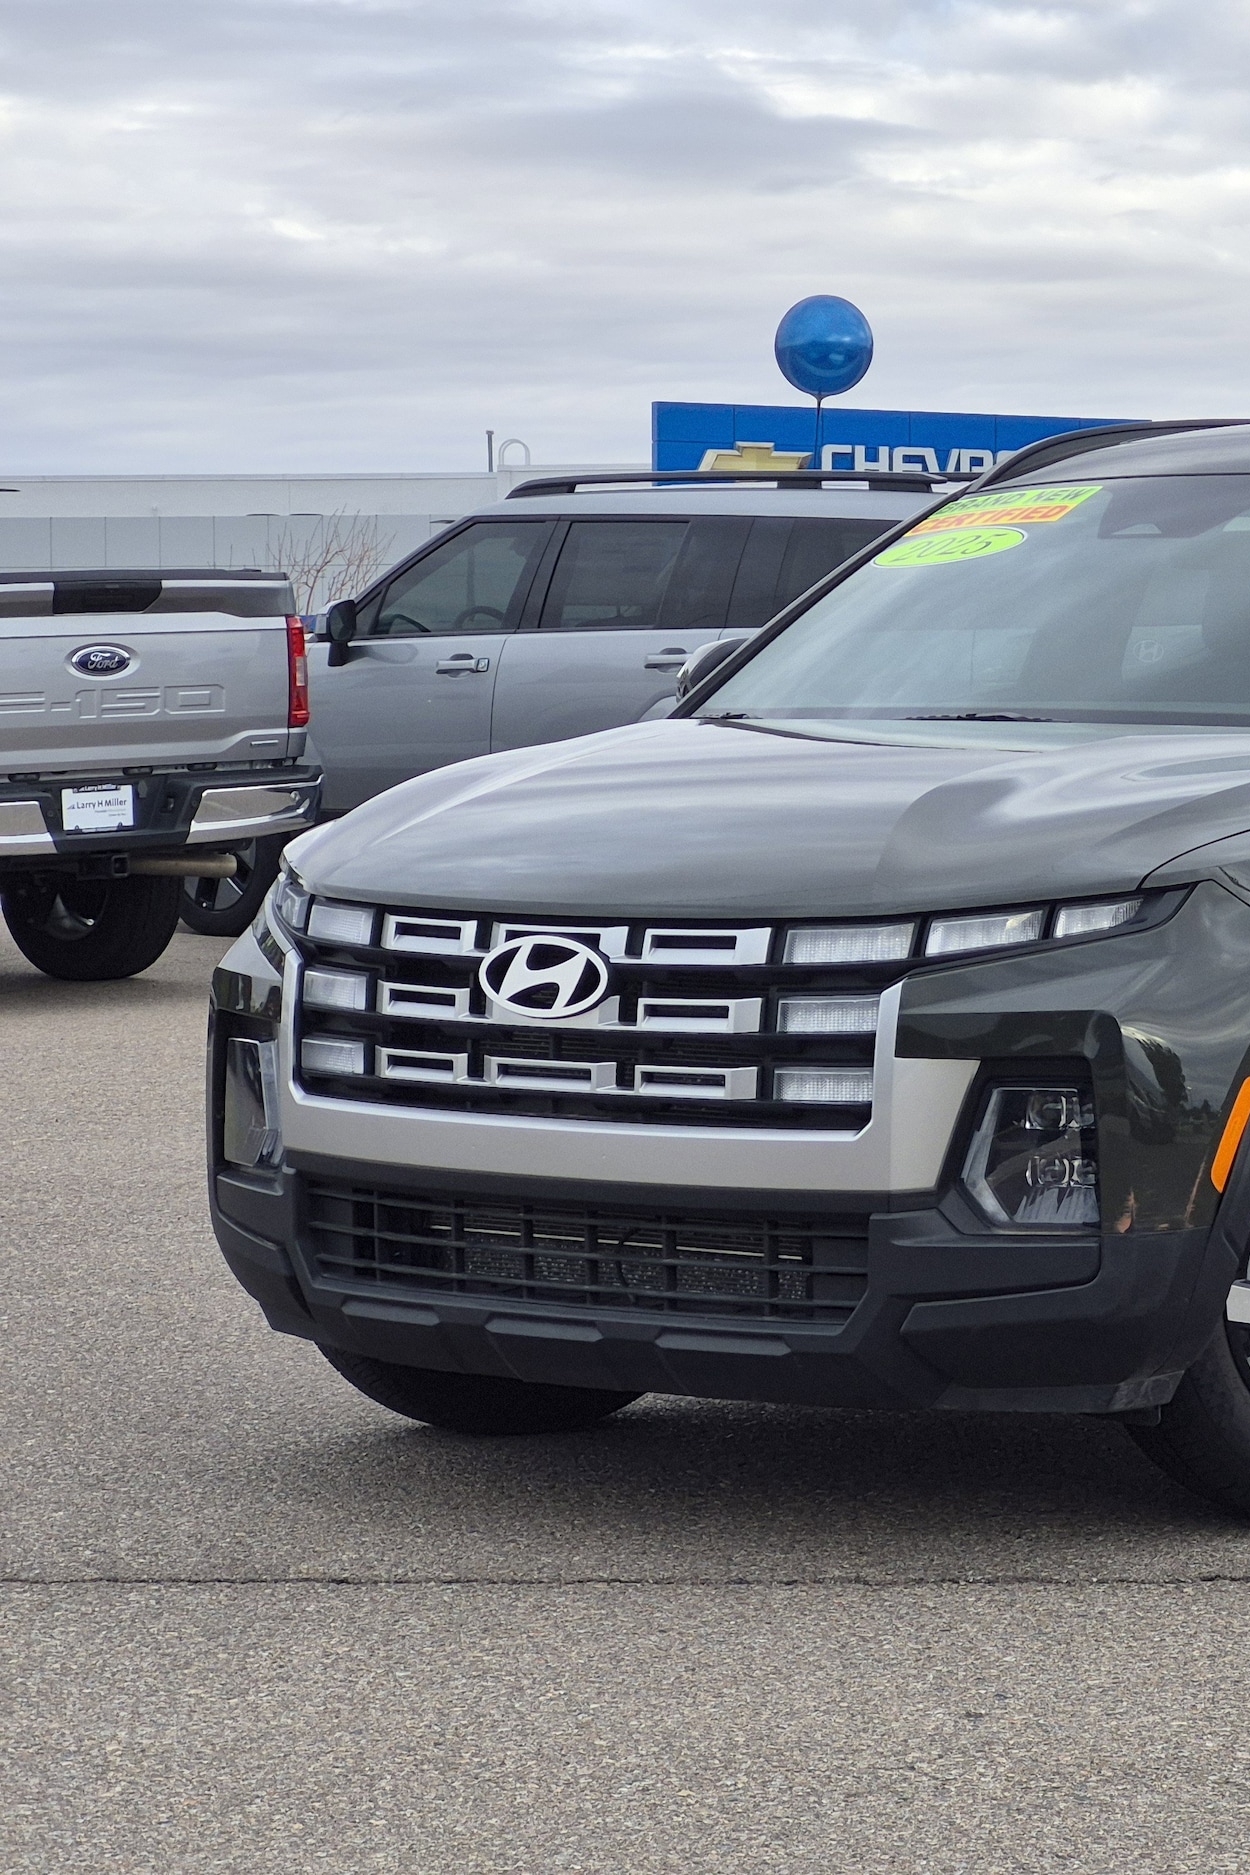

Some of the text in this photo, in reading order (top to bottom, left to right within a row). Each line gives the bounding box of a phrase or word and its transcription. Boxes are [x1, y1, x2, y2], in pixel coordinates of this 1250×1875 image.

[821, 443, 1018, 473] CHEVR
[935, 486, 1088, 515] BRAND NEW
[911, 504, 1070, 534] CERTIFIED
[892, 533, 1008, 563] 2025
[87, 652, 119, 669] Ford
[76, 798, 127, 810] Larry H Miller
